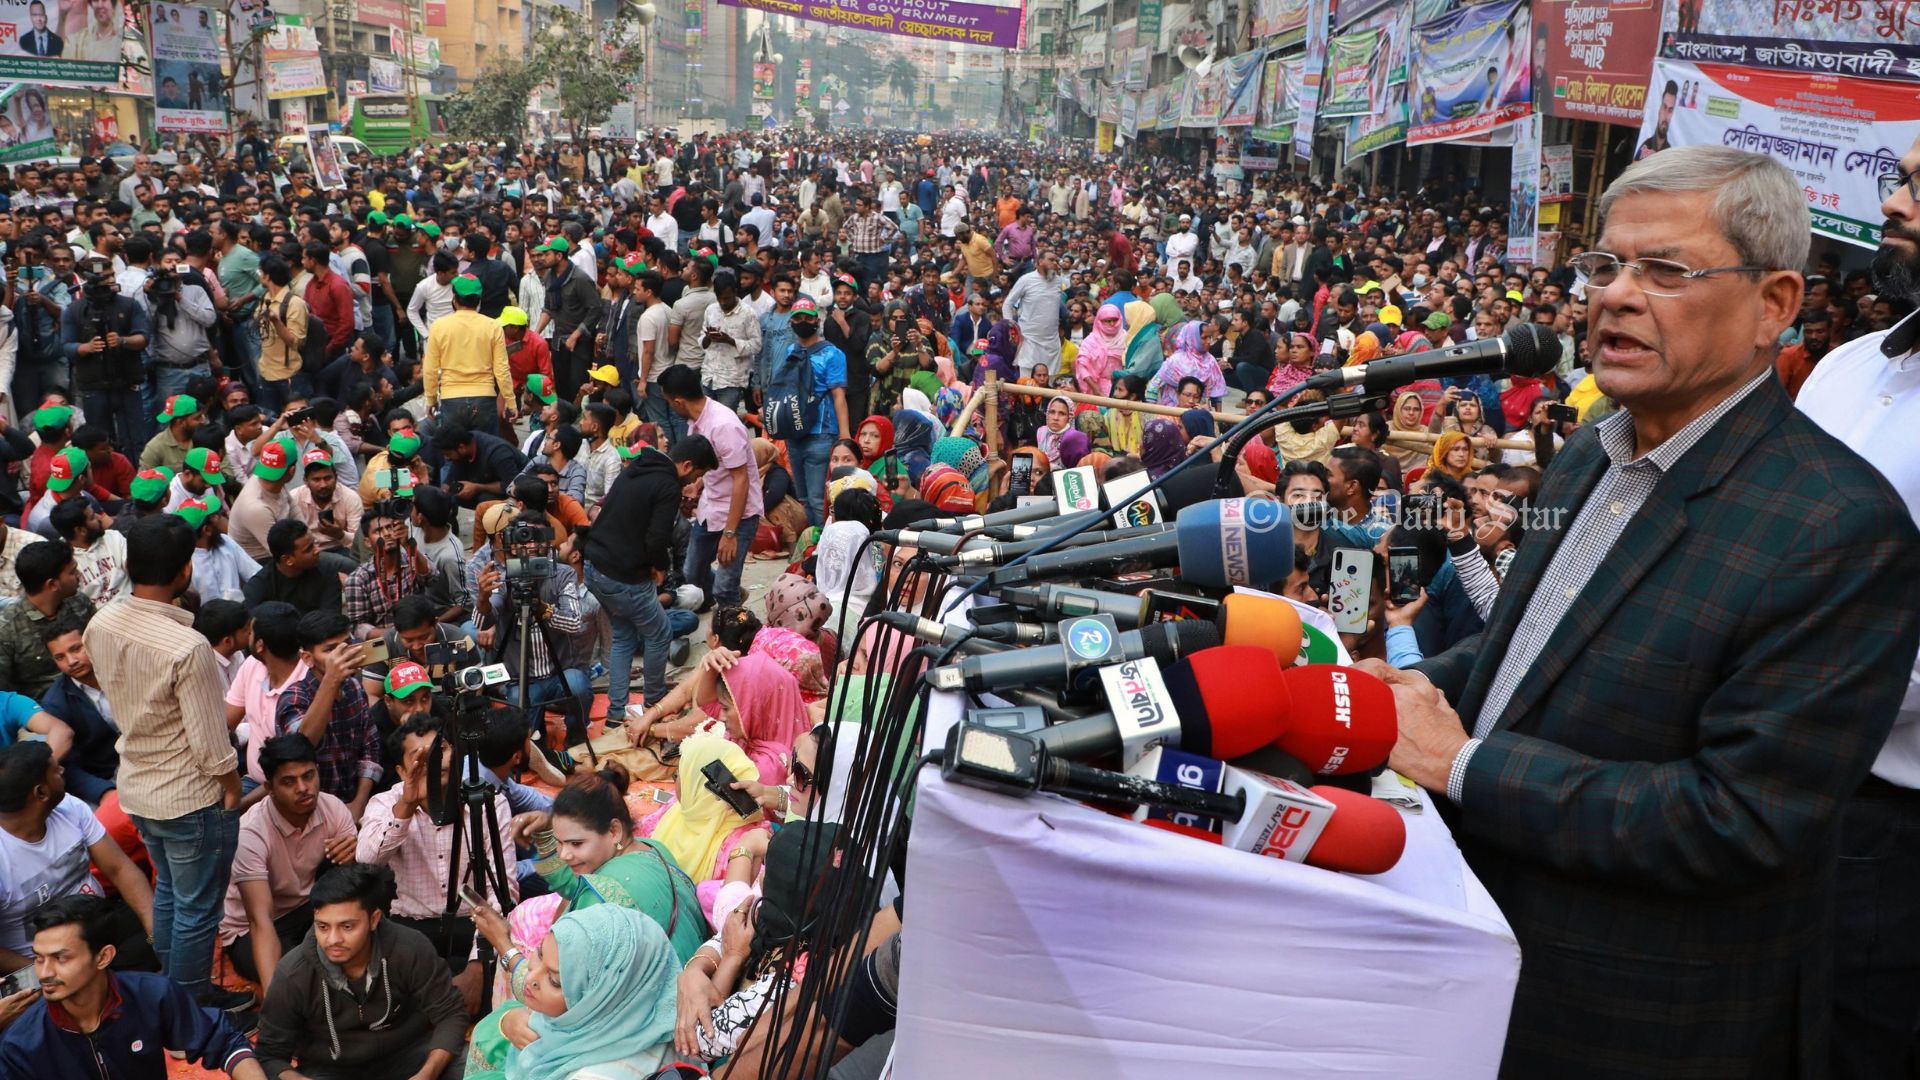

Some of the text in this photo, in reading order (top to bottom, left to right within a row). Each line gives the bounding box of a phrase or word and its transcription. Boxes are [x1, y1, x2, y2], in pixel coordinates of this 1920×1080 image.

[809, 5, 894, 29] জাতীয়তাবাদী
[969, 29, 993, 42] দল
[867, 2, 979, 25] GOVERNMENT
[1676, 40, 1747, 62] বাংলাদেশ
[1755, 43, 1898, 74] জাতীয়তাবাদী
[1611, 83, 1647, 107] হোসেন
[1845, 147, 1901, 177] সেলি
[1821, 193, 1840, 211] চাই
[790, 394, 804, 431] SIMURA
[1331, 671, 1351, 722] DESH
